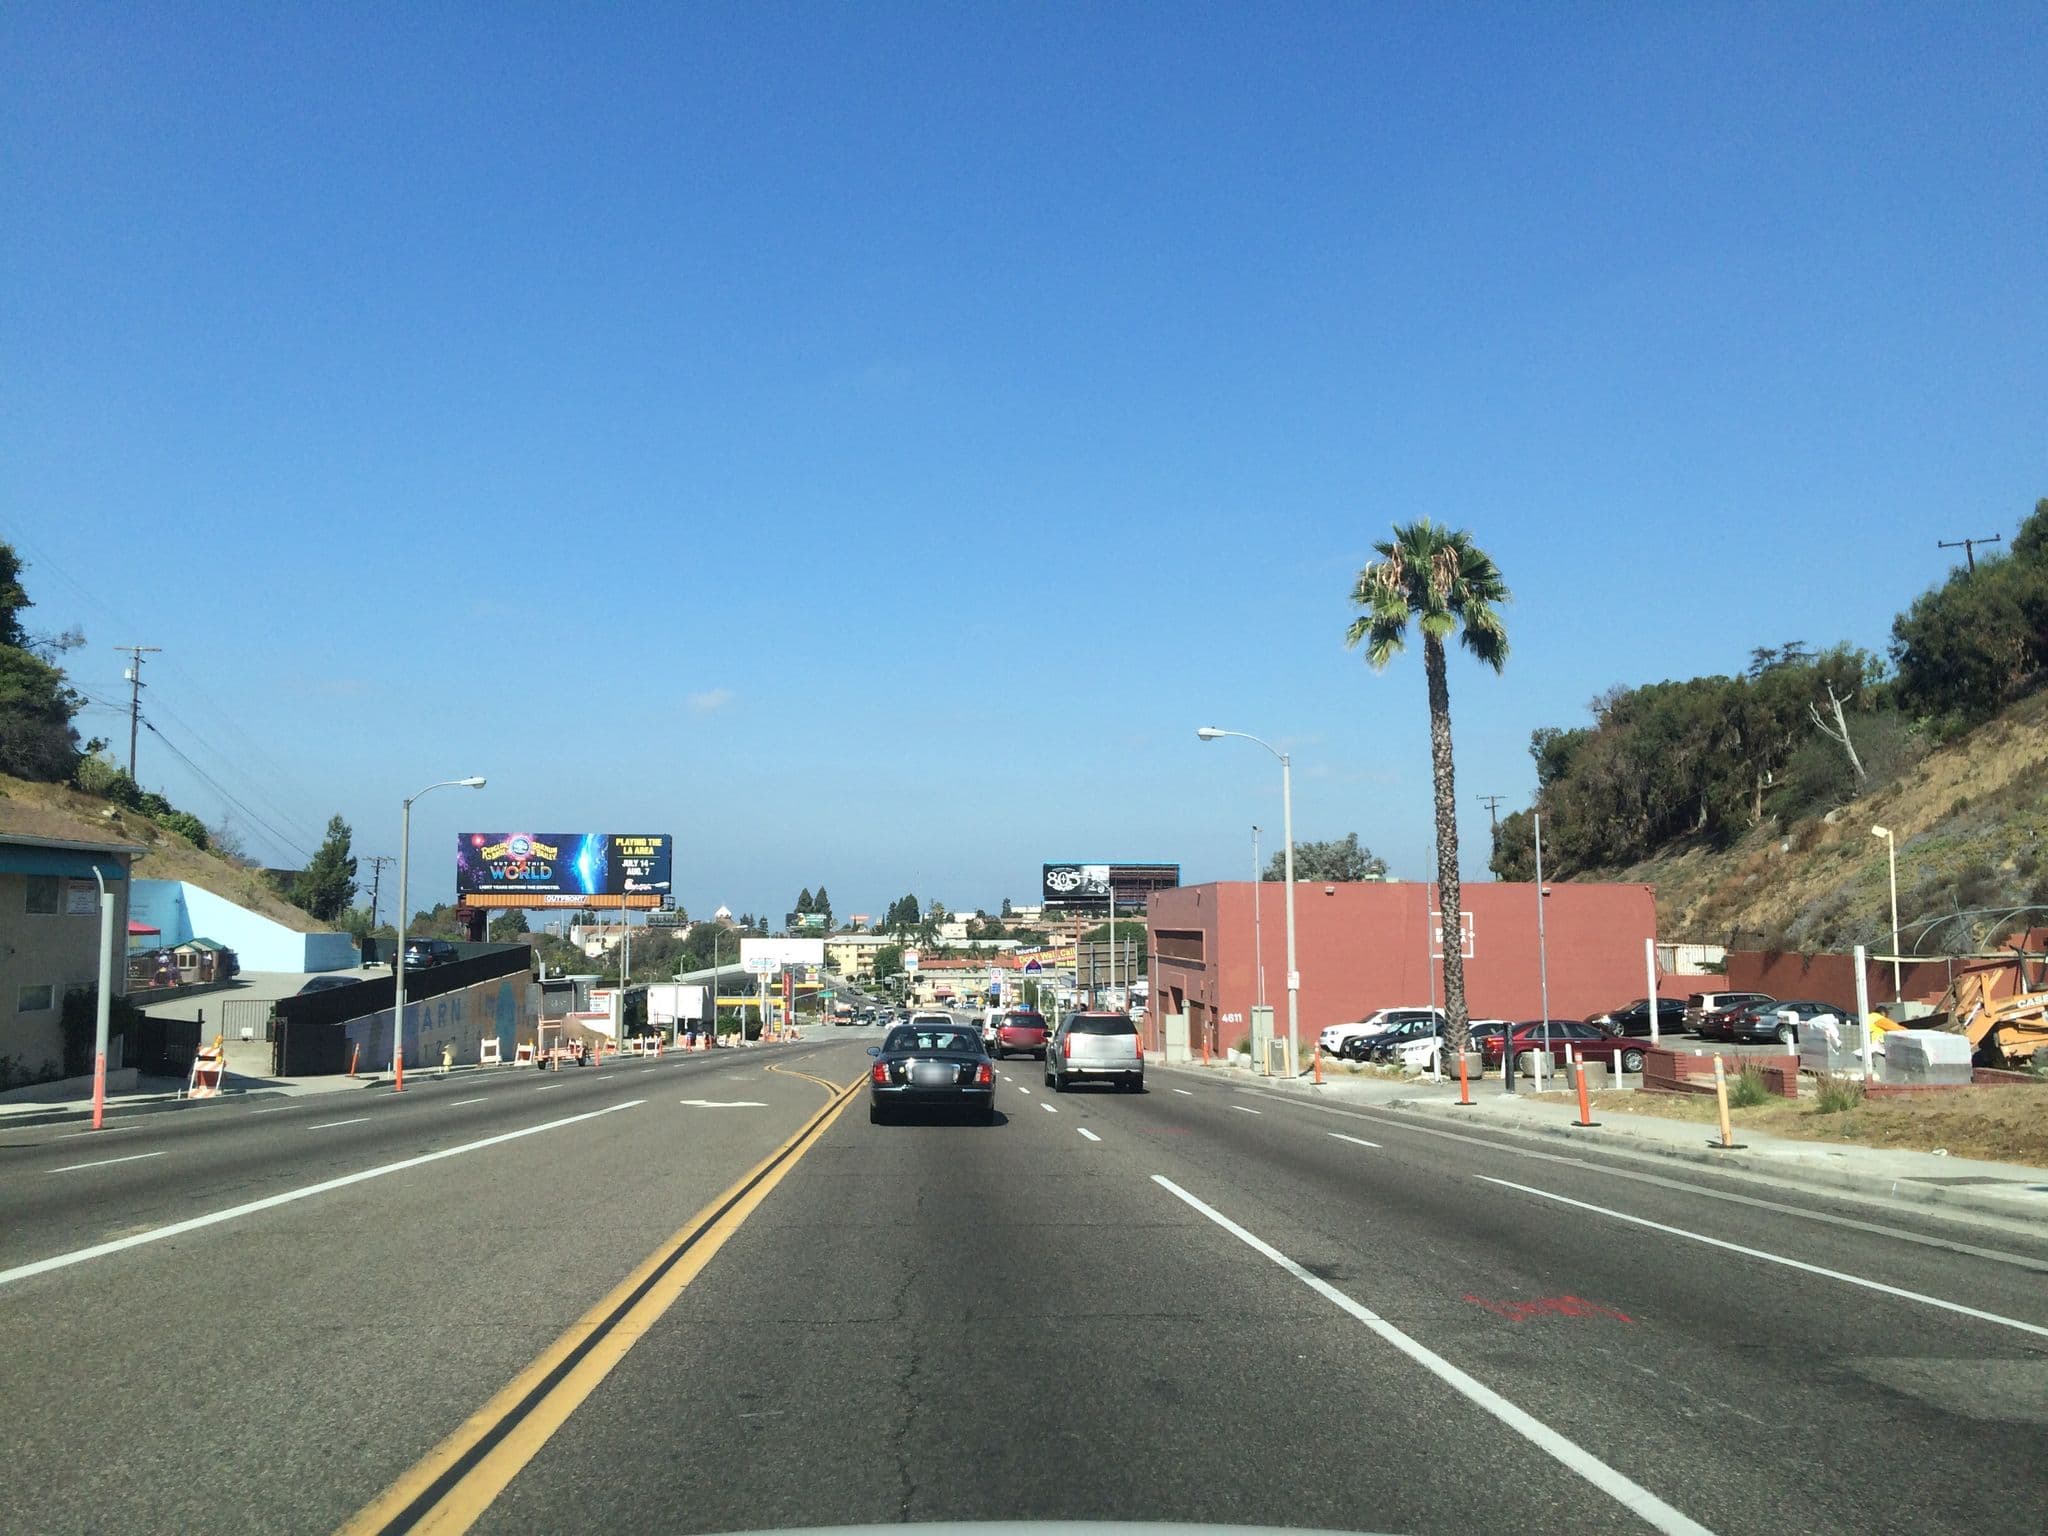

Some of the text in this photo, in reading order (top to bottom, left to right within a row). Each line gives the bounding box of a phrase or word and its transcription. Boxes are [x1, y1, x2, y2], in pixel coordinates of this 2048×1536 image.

[615, 838, 662, 846] PLAYING THE
[623, 846, 654, 855] LA AREA
[621, 859, 639, 867] JULY
[640, 859, 649, 867] 14
[489, 865, 553, 880] WORLD
[645, 867, 650, 876] 7
[1046, 871, 1081, 887] 805
[2017, 994, 2048, 1008] CASE
[1221, 1012, 1242, 1023] 4611
